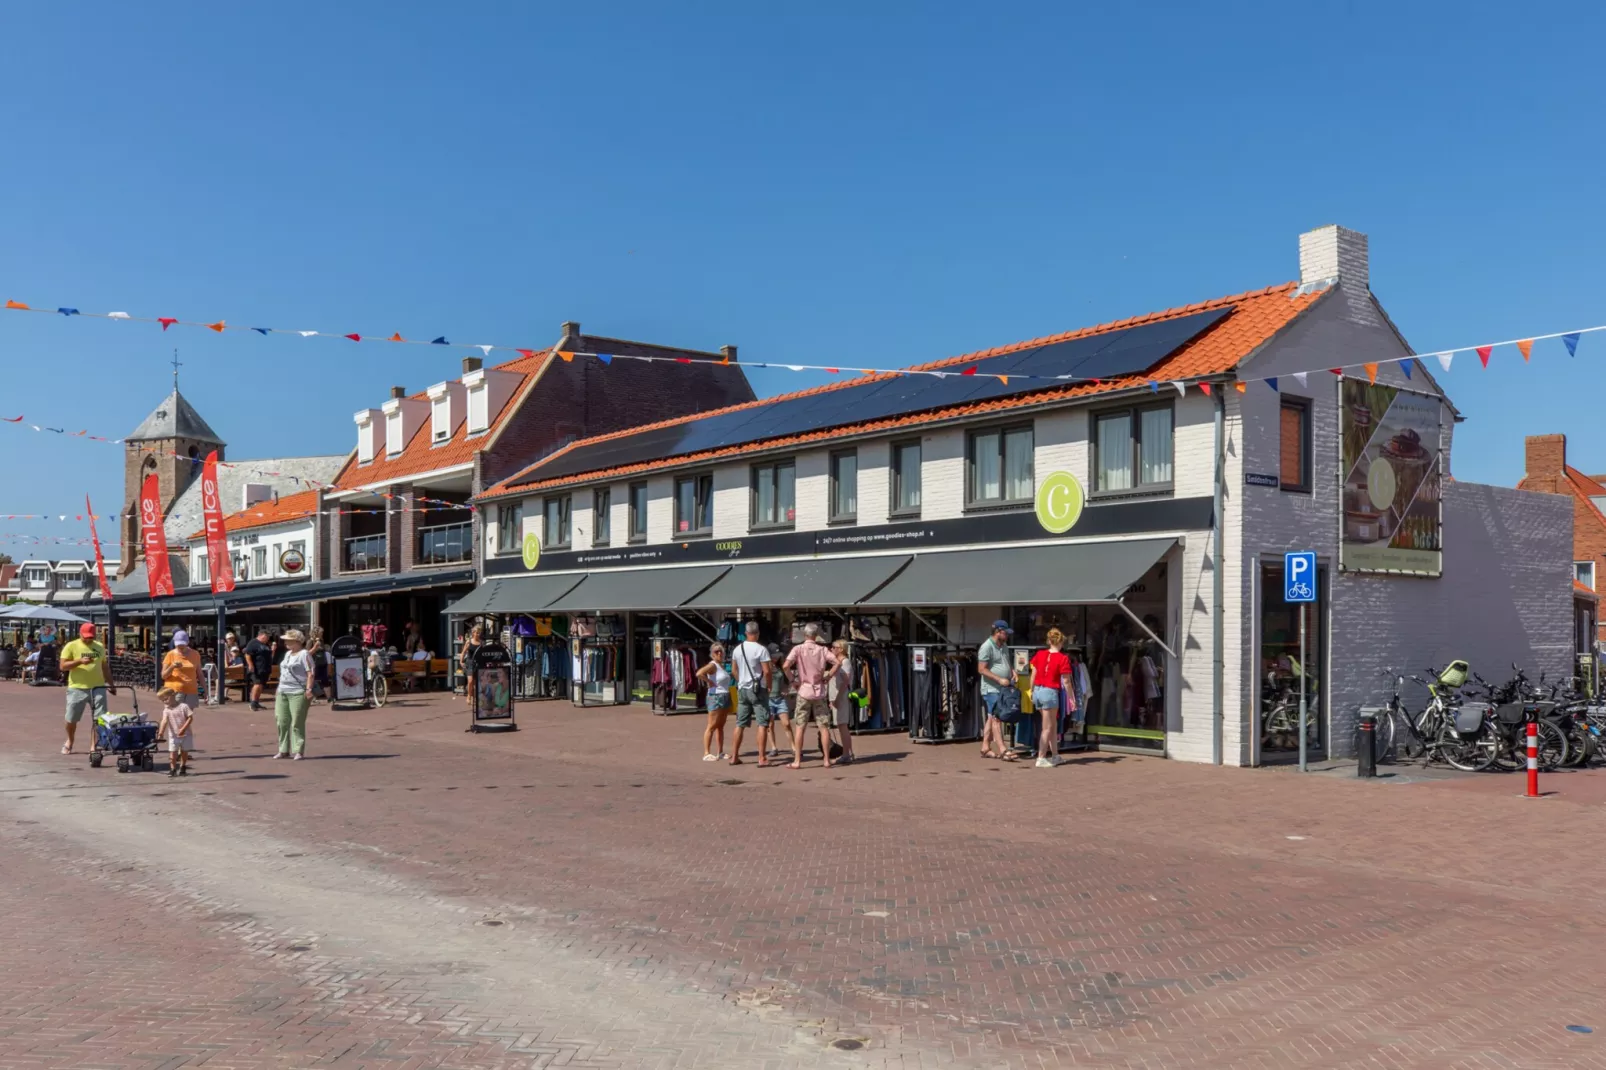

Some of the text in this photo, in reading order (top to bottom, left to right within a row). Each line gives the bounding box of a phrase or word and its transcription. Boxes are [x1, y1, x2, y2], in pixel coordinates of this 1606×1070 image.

[203, 479, 217, 513] Ice
[1047, 483, 1071, 520] G
[142, 498, 157, 528] Ice
[526, 539, 536, 562] G
[846, 535, 867, 544] shopping
[873, 530, 925, 541] www.goodies-shop.nl
[1292, 557, 1309, 582] P
